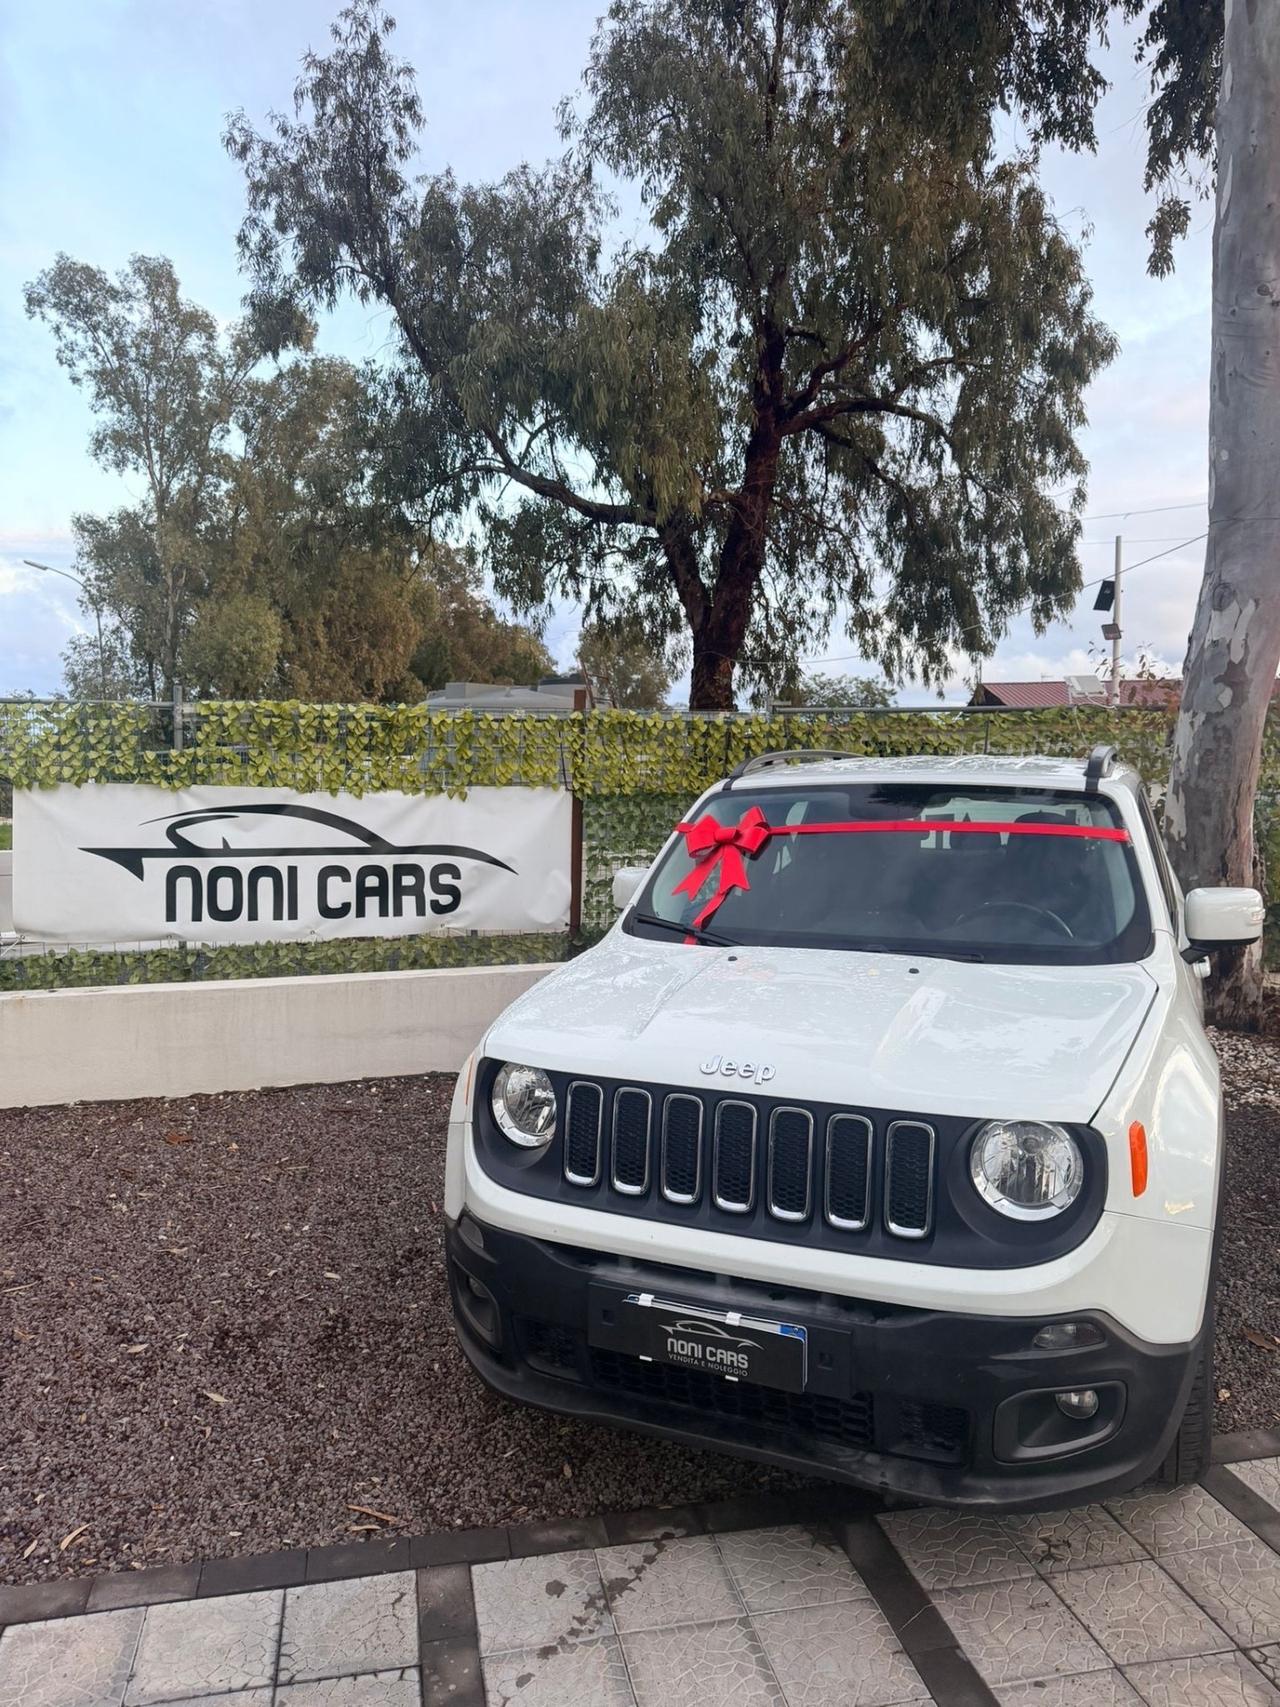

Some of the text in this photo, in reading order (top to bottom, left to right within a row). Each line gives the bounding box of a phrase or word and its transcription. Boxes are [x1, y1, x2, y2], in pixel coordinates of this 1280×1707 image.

[165, 863, 462, 922] NONI CARS
[699, 1054, 776, 1085] Jeep
[667, 1337, 749, 1369] NONI CARS
[668, 1353, 699, 1366] VENDITA
[707, 1362, 748, 1377] NOLEGGIO
